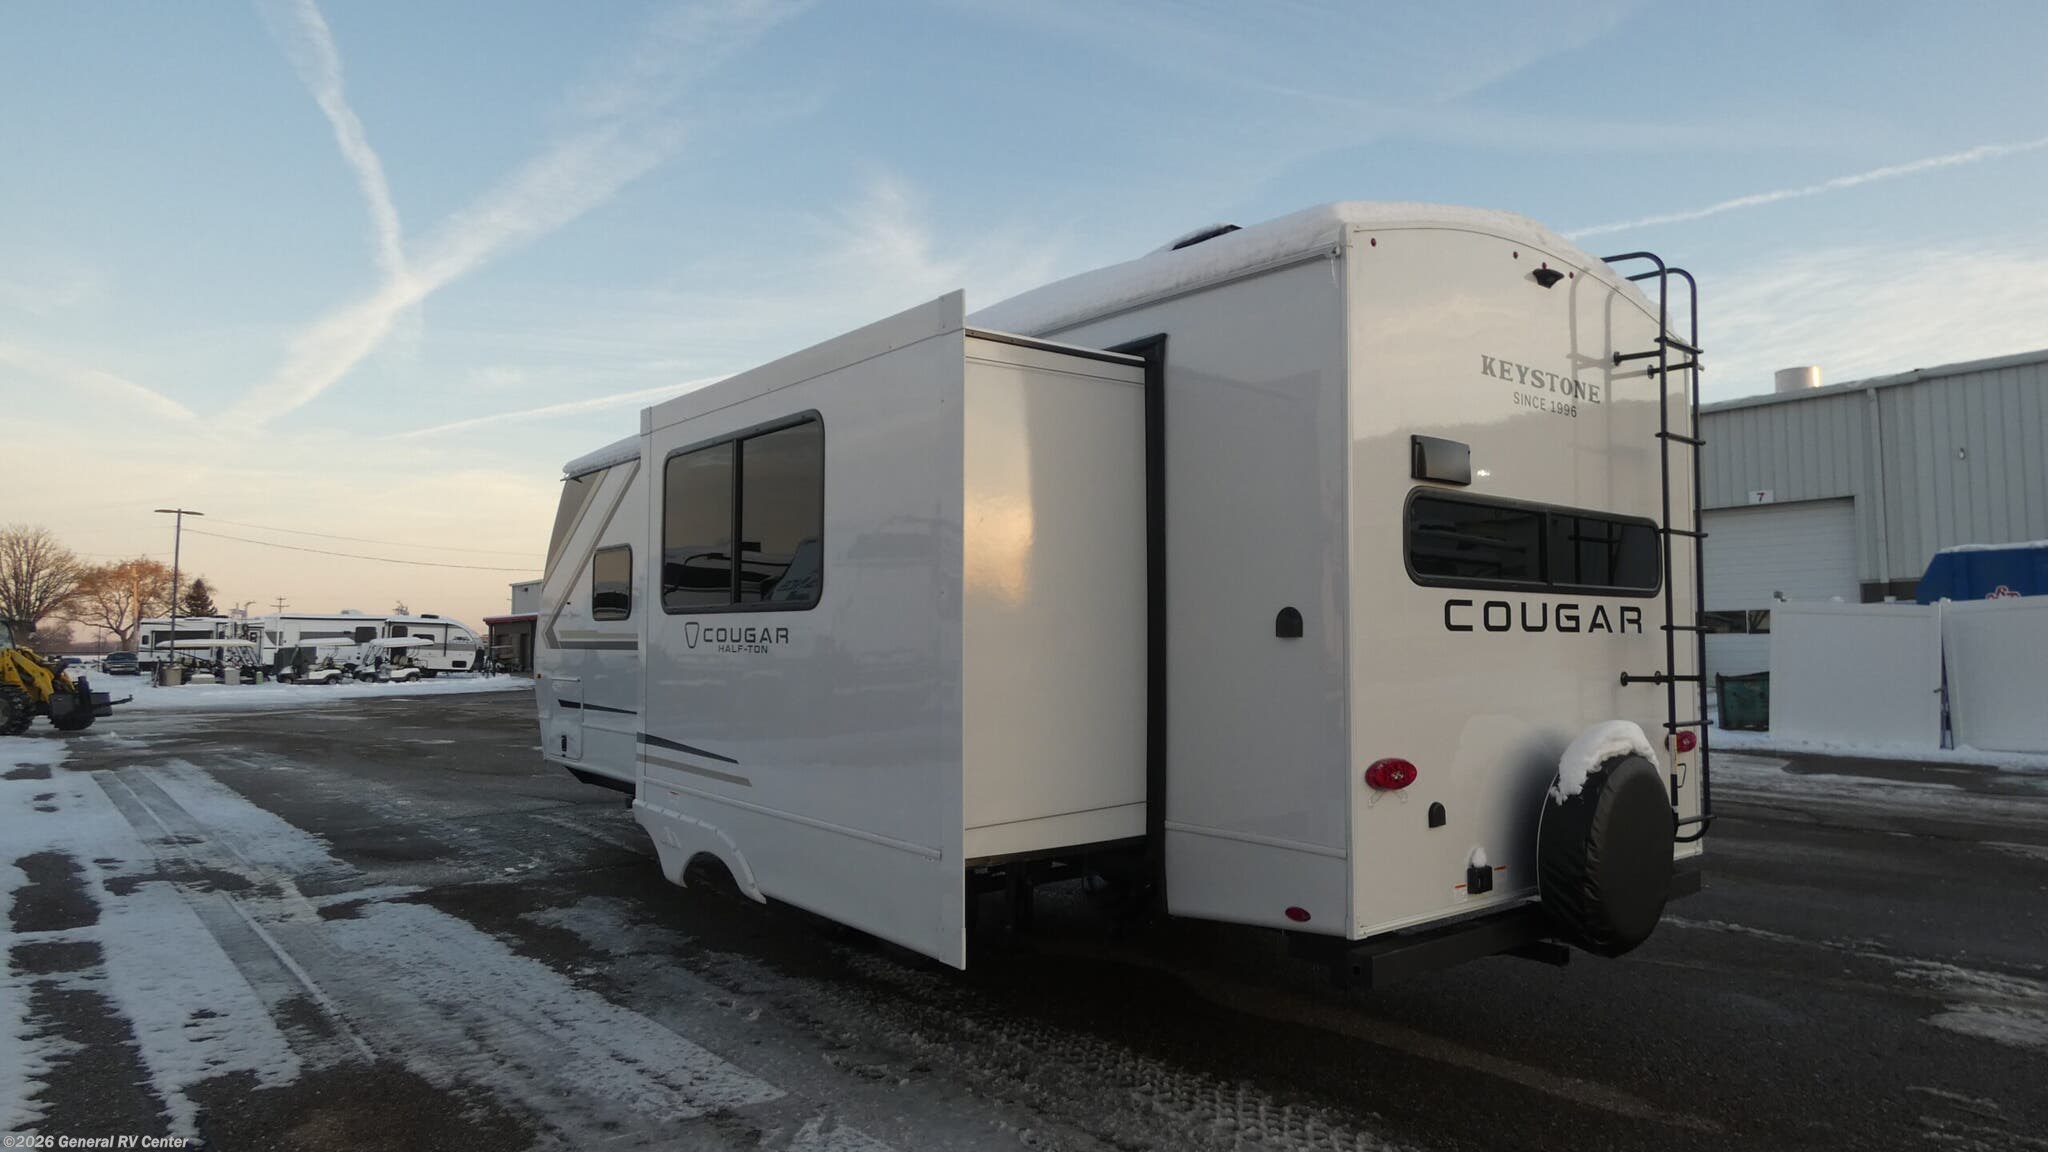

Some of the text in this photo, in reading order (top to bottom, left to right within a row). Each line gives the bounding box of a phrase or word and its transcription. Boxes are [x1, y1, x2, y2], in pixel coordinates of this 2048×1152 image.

[1481, 354, 1601, 404] KEYSTONE
[1513, 391, 1577, 418] SINCE 1996
[1756, 491, 1765, 502] 7
[1444, 599, 1643, 634] COUGAR
[703, 627, 789, 644] COUGAR
[718, 644, 768, 654] HALF-TON
